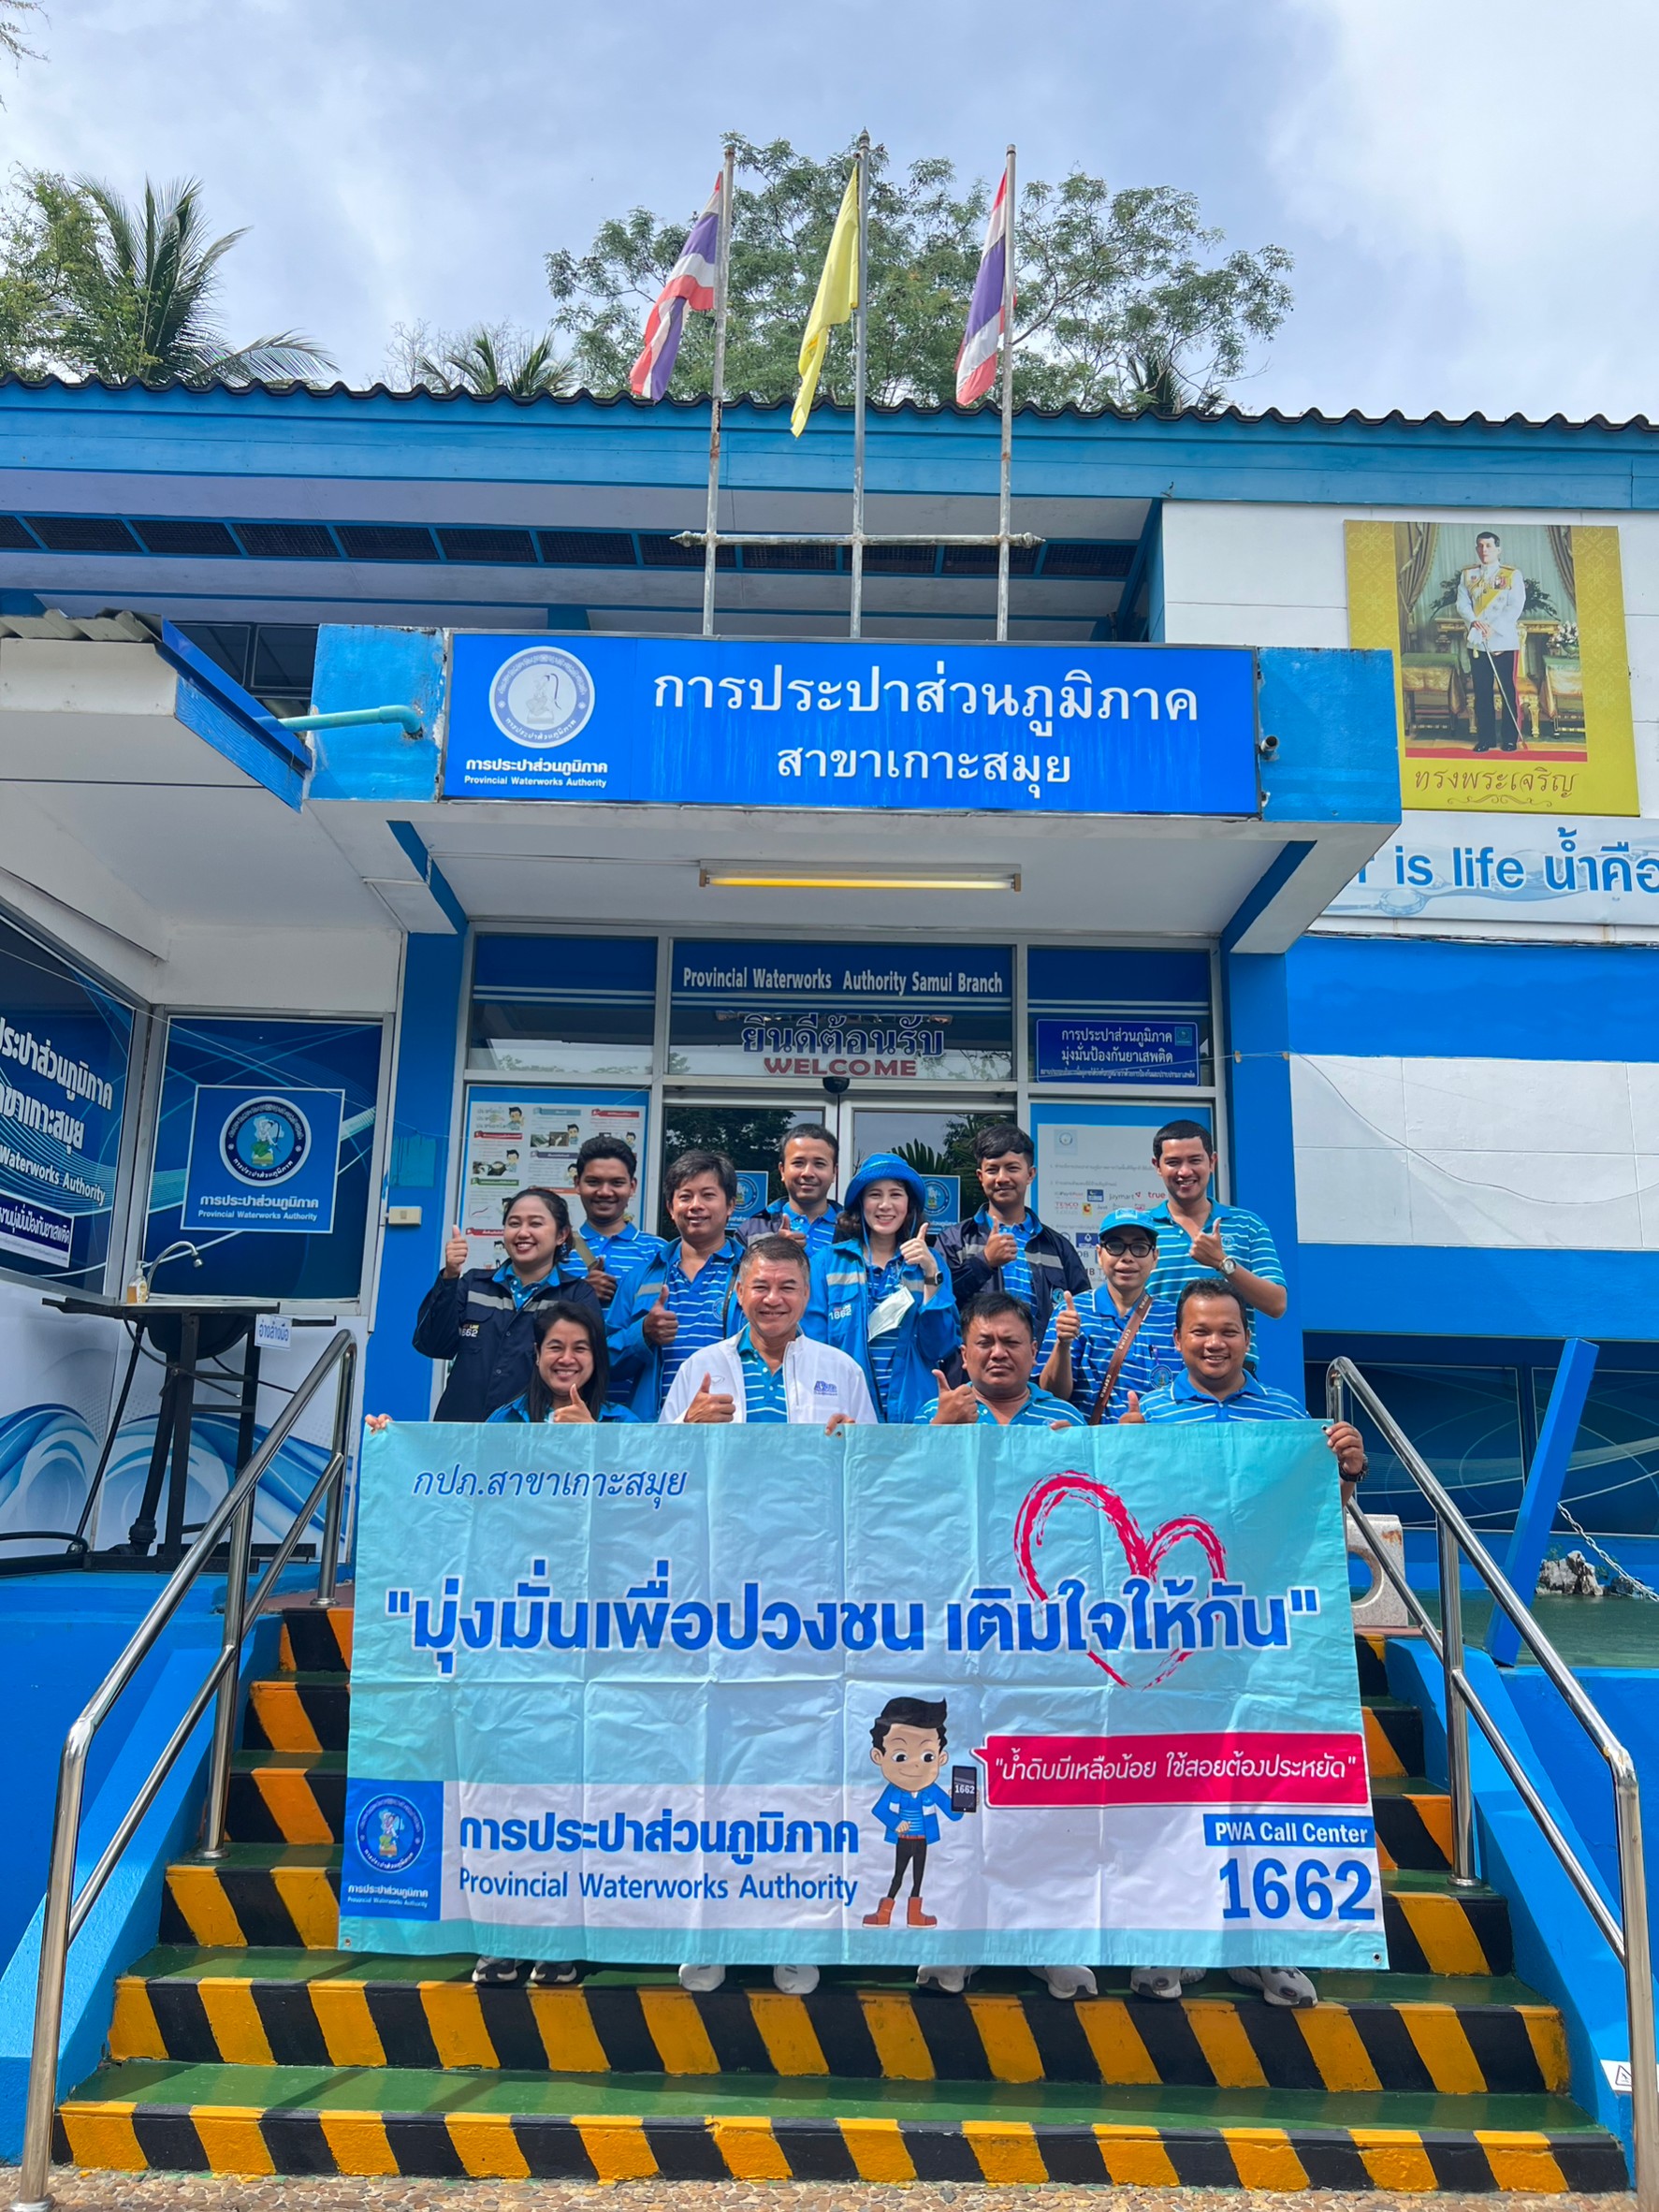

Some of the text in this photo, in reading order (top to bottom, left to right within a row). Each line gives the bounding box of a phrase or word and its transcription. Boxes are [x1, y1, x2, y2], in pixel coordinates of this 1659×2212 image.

[654, 661, 1198, 736] การประปาส่วนภูมิภาค
[464, 775, 606, 789] Provincial Waterworks Authority
[466, 758, 608, 776] การประปาส่วนภูมิภาค
[778, 744, 1070, 798] สาขาเกาะสมุย
[1415, 766, 1579, 798] ทรงพระเจริญ
[1395, 845, 1433, 885] is
[1452, 846, 1524, 889] life
[684, 967, 1003, 997] Provincial Waterworks Authority Samui Branch
[741, 1012, 944, 1056] ยินดีต้อนรับ
[1061, 1026, 1172, 1047] การประปาส่วนภูมิภาค
[764, 1057, 917, 1077] WELCOME
[1061, 1042, 1173, 1066] มุ่งมั่นป้องกันยาเสพติด
[0, 1144, 106, 1207] Waterworks Authority
[198, 1209, 318, 1222] Provincial Waterworks Authority
[199, 1194, 319, 1211] การประปาส่วนภูมิภาค
[413, 1464, 689, 1509] กปภ.สาขาเกาะสมุย
[386, 1558, 1319, 1674] "มุ่งมั่นเพื่อปวงชน เติมใจให้กัน"
[995, 1747, 1356, 1781] "น้ำดิบมีเหลือน้อย ใช้สอยต้องประหยัด"
[954, 1784, 975, 1795] 1662
[459, 1808, 858, 1865] การประปาส่วนภูมิภาค
[1215, 1821, 1368, 1843] PWA Call Center
[459, 1870, 858, 1906] Provincial Waterworks Authority
[1219, 1857, 1375, 1920] 1662
